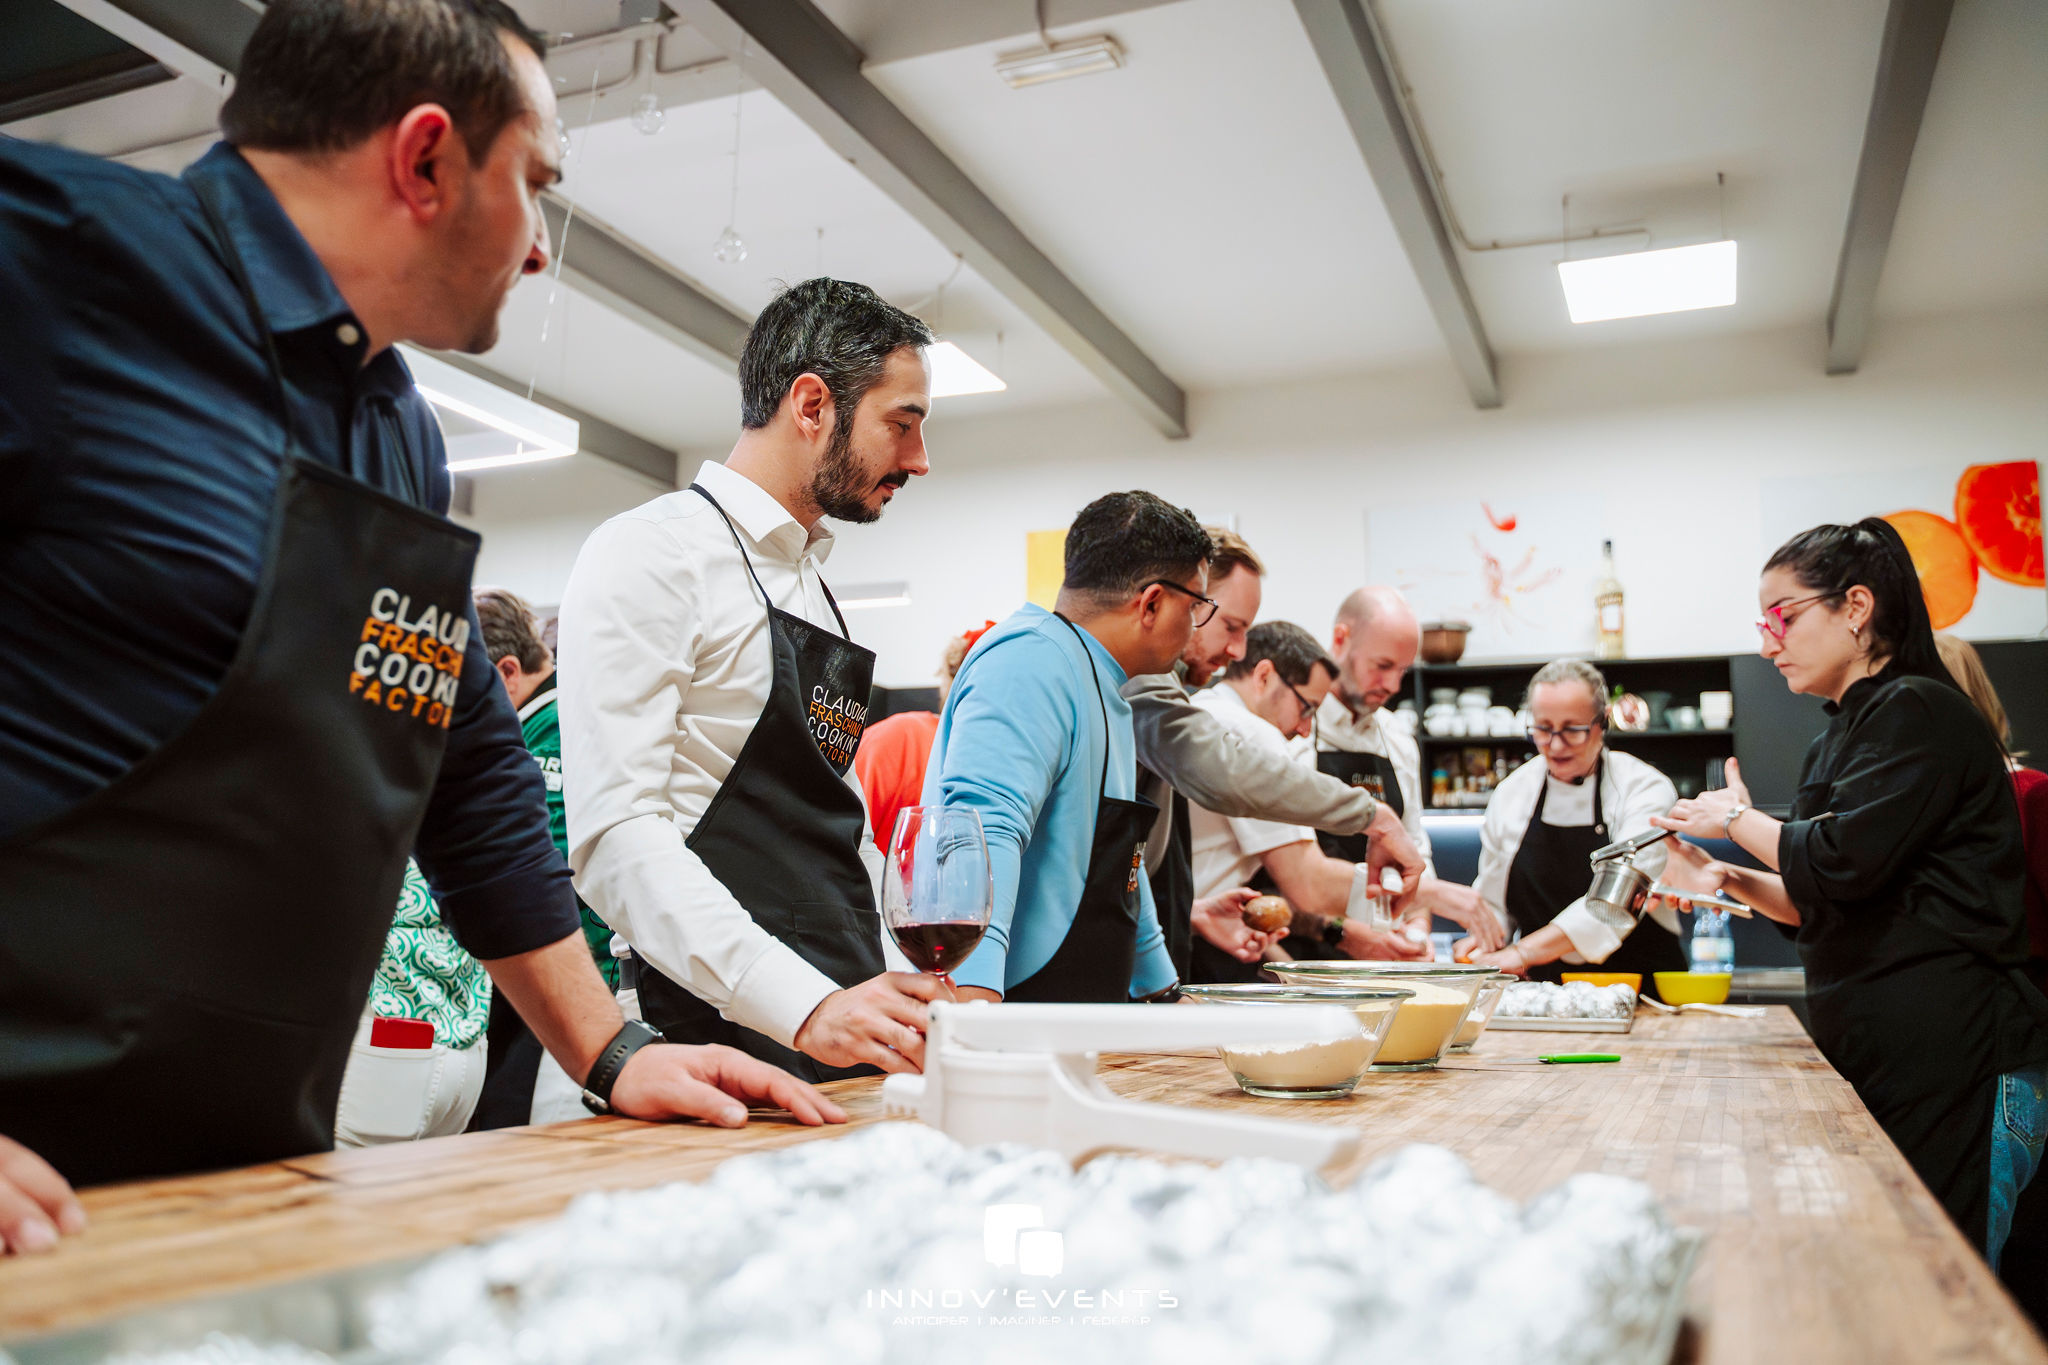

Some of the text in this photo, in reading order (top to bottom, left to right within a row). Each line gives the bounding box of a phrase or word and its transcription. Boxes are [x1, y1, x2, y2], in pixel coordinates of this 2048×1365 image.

[809, 701, 863, 738] FRASCHINI
[812, 685, 869, 724] CLAUDIA
[814, 738, 850, 766] CTORY
